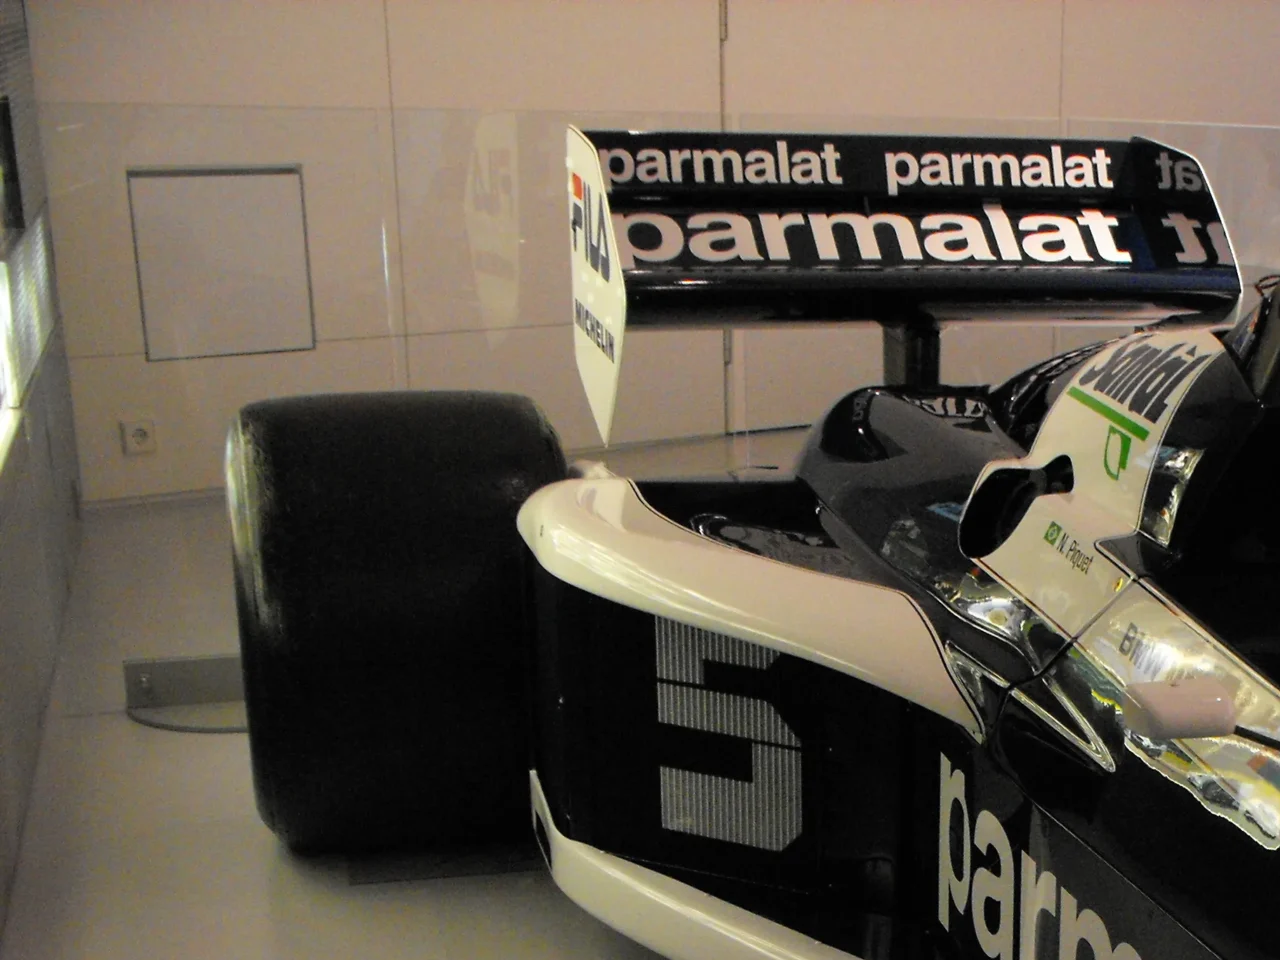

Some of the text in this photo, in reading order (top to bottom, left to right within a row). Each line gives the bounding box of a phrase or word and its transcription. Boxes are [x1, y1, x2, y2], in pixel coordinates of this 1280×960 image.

[600, 141, 1114, 195] parmalat parmalat
[612, 203, 1132, 268] parmalat
[575, 298, 615, 364] MICHELIN
[1065, 539, 1094, 575] Piquet
[654, 614, 802, 852] 5
